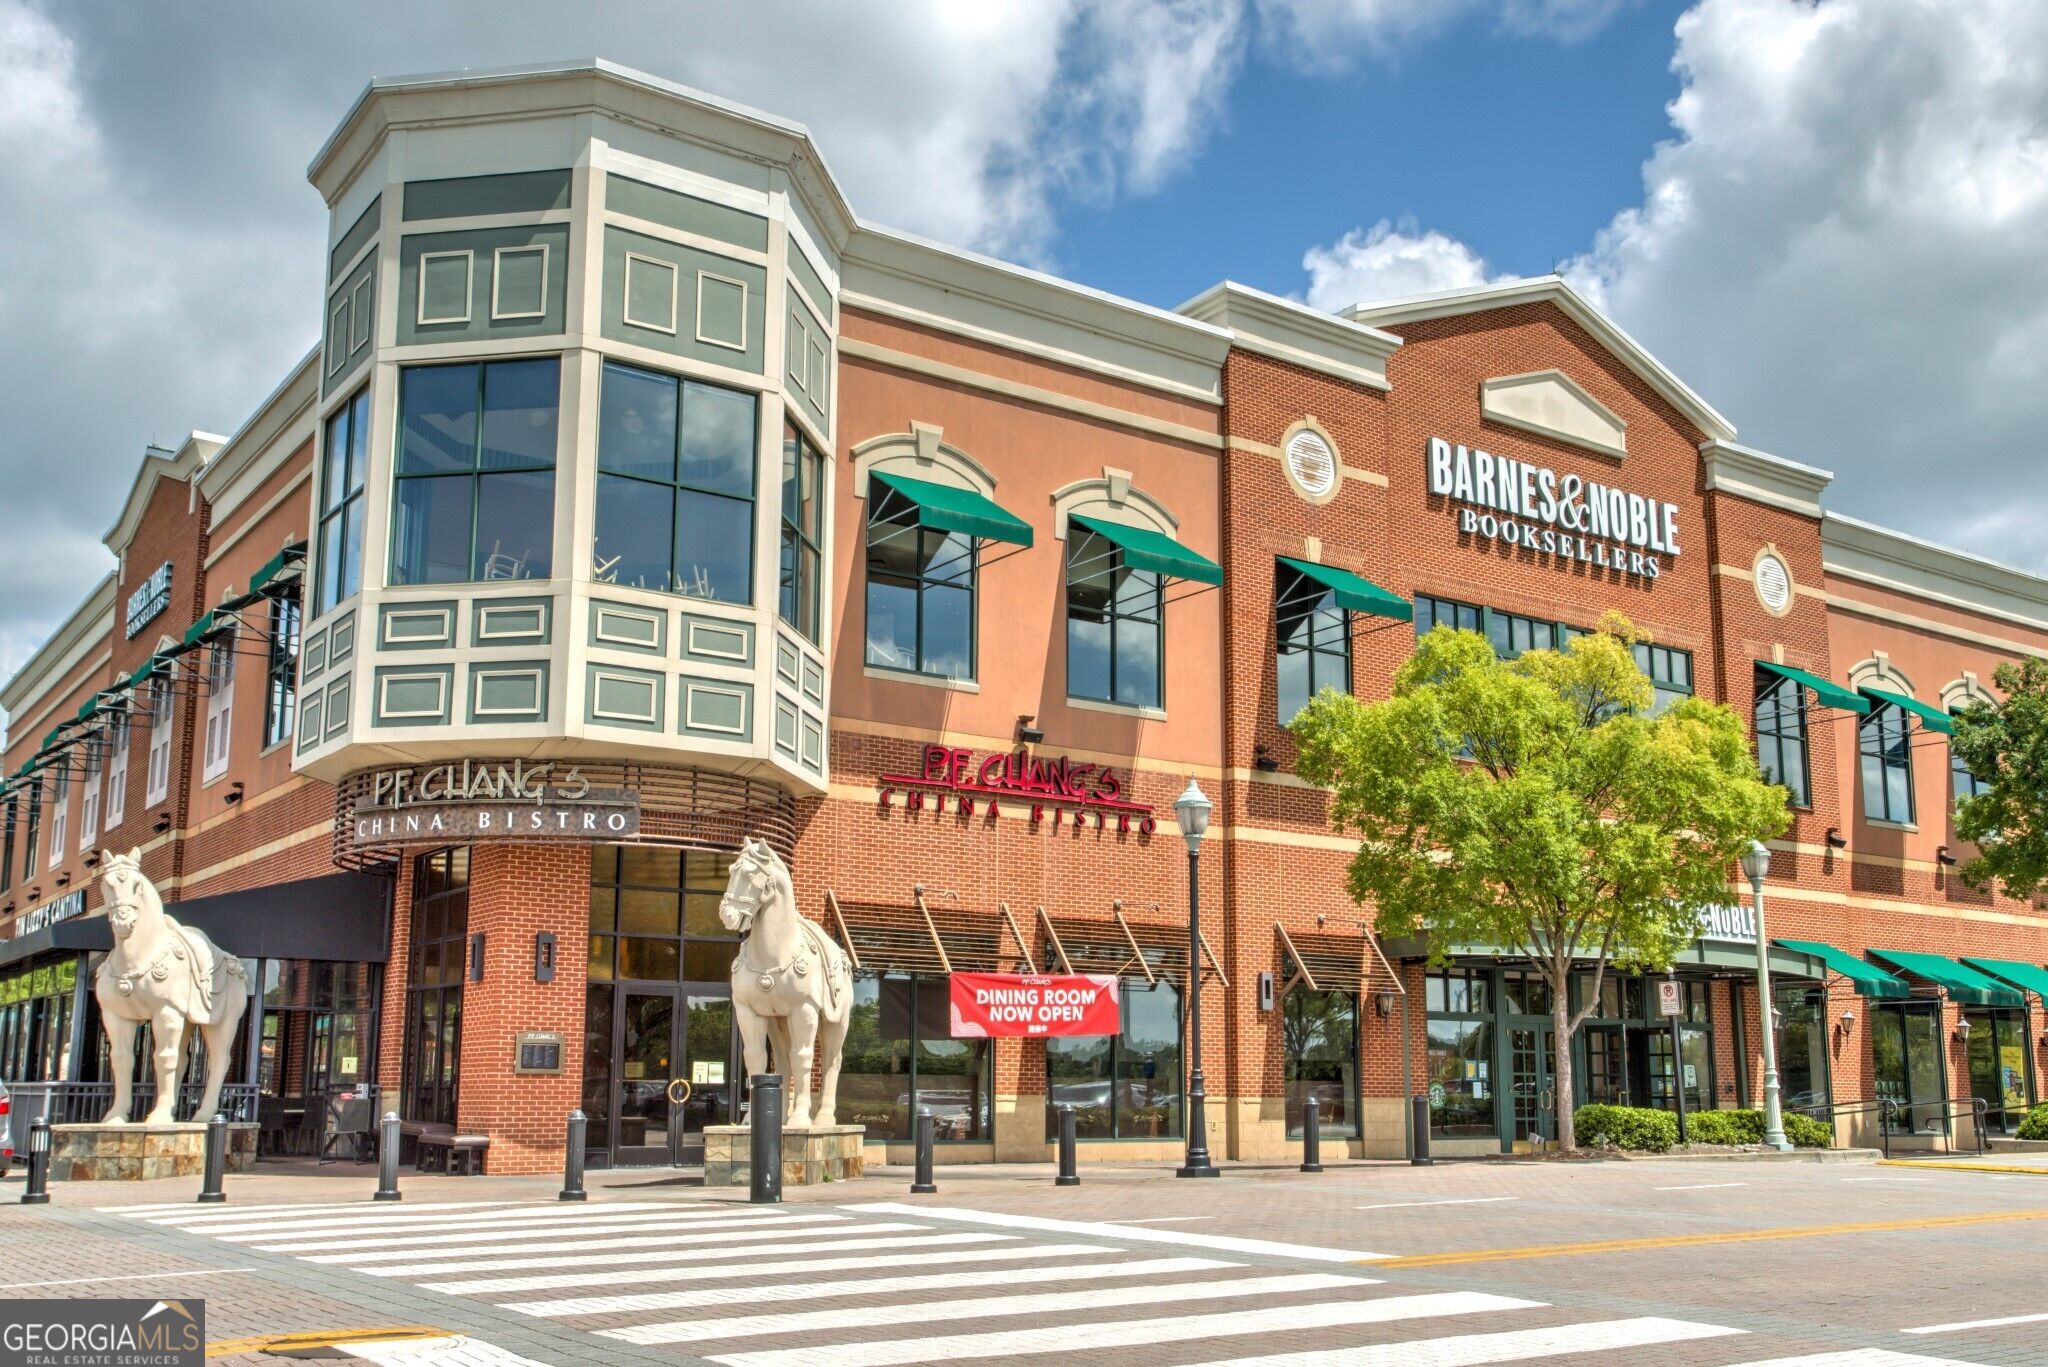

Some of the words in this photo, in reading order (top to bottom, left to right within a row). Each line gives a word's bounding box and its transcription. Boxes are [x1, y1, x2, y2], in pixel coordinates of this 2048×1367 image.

[1460, 508, 1660, 578] BOOKSELLERS
[358, 814, 444, 838] CHINA
[478, 811, 626, 832] BISTRO
[880, 787, 1000, 818] CHINA
[1031, 804, 1157, 835] BISTRO
[50, 889, 83, 924] CANTINA
[976, 989, 1039, 1006] DINING
[1044, 989, 1096, 1006] ROOM
[989, 1005, 1033, 1022] NOW
[1038, 1005, 1084, 1022] OPEN
